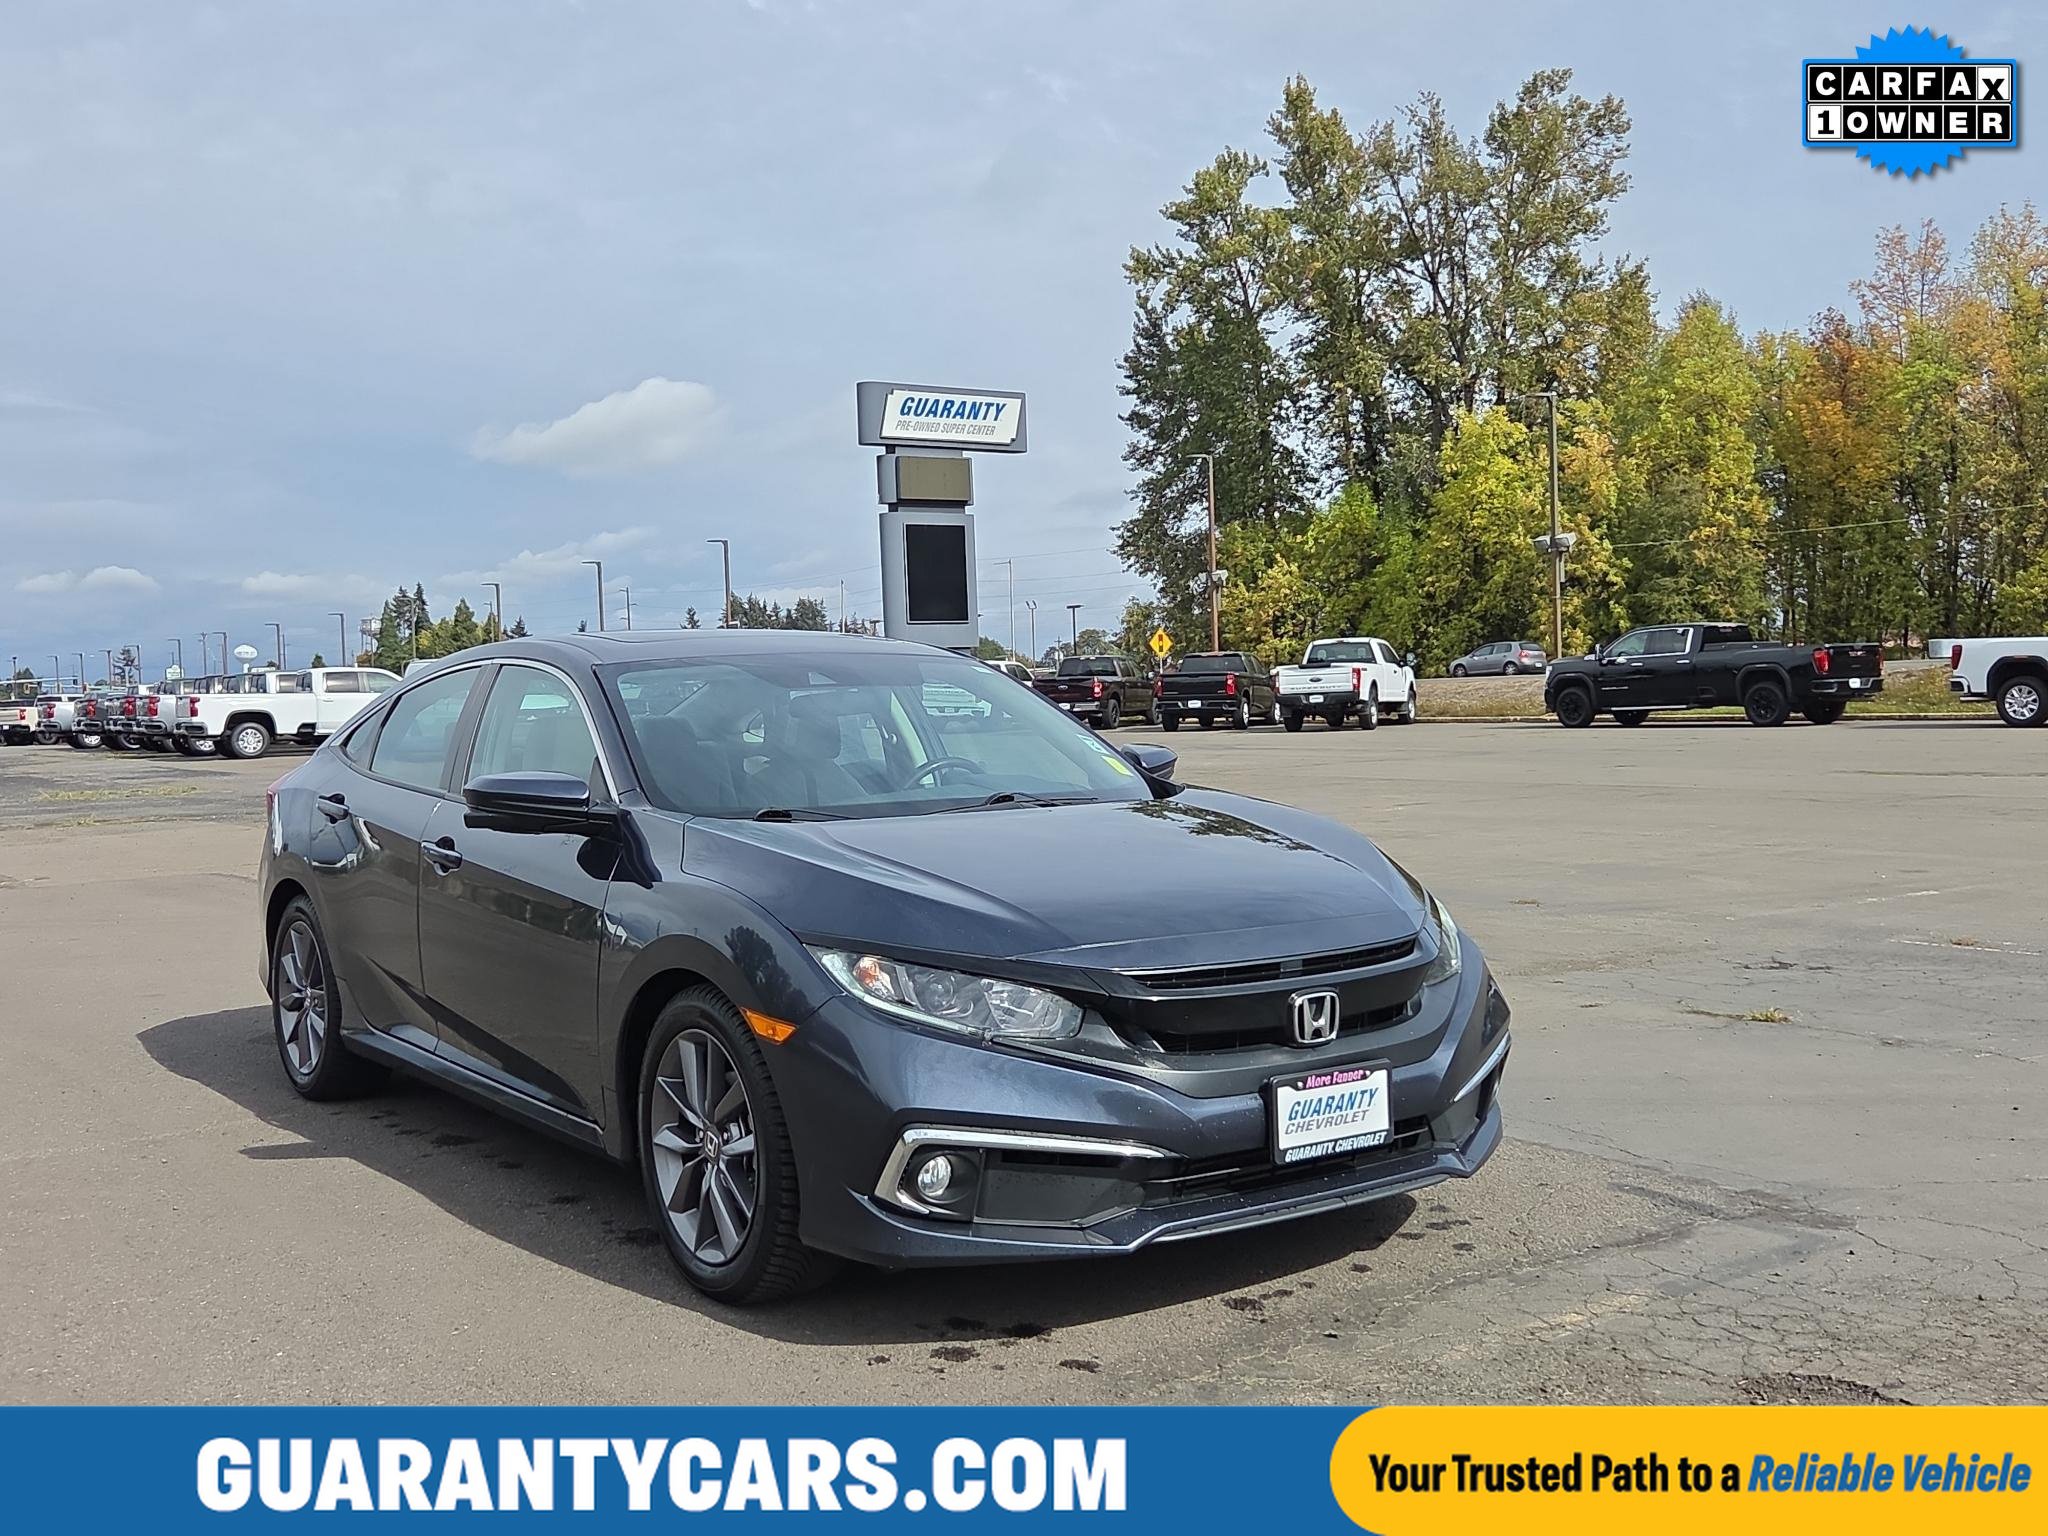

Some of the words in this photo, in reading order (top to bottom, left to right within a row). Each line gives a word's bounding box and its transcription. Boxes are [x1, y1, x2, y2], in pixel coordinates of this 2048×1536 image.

[900, 396, 1007, 422] GUARANTY
[895, 420, 941, 433] PRE-OWNED
[941, 422, 966, 434] SUPER
[966, 424, 996, 436] CENTER
[1306, 1074, 1331, 1088] More
[1288, 1087, 1379, 1121] GUARANTY
[1284, 1109, 1369, 1135] CHEVROLET
[1284, 1141, 1334, 1162] GUARANTY
[1335, 1131, 1388, 1152] CHEVROLET
